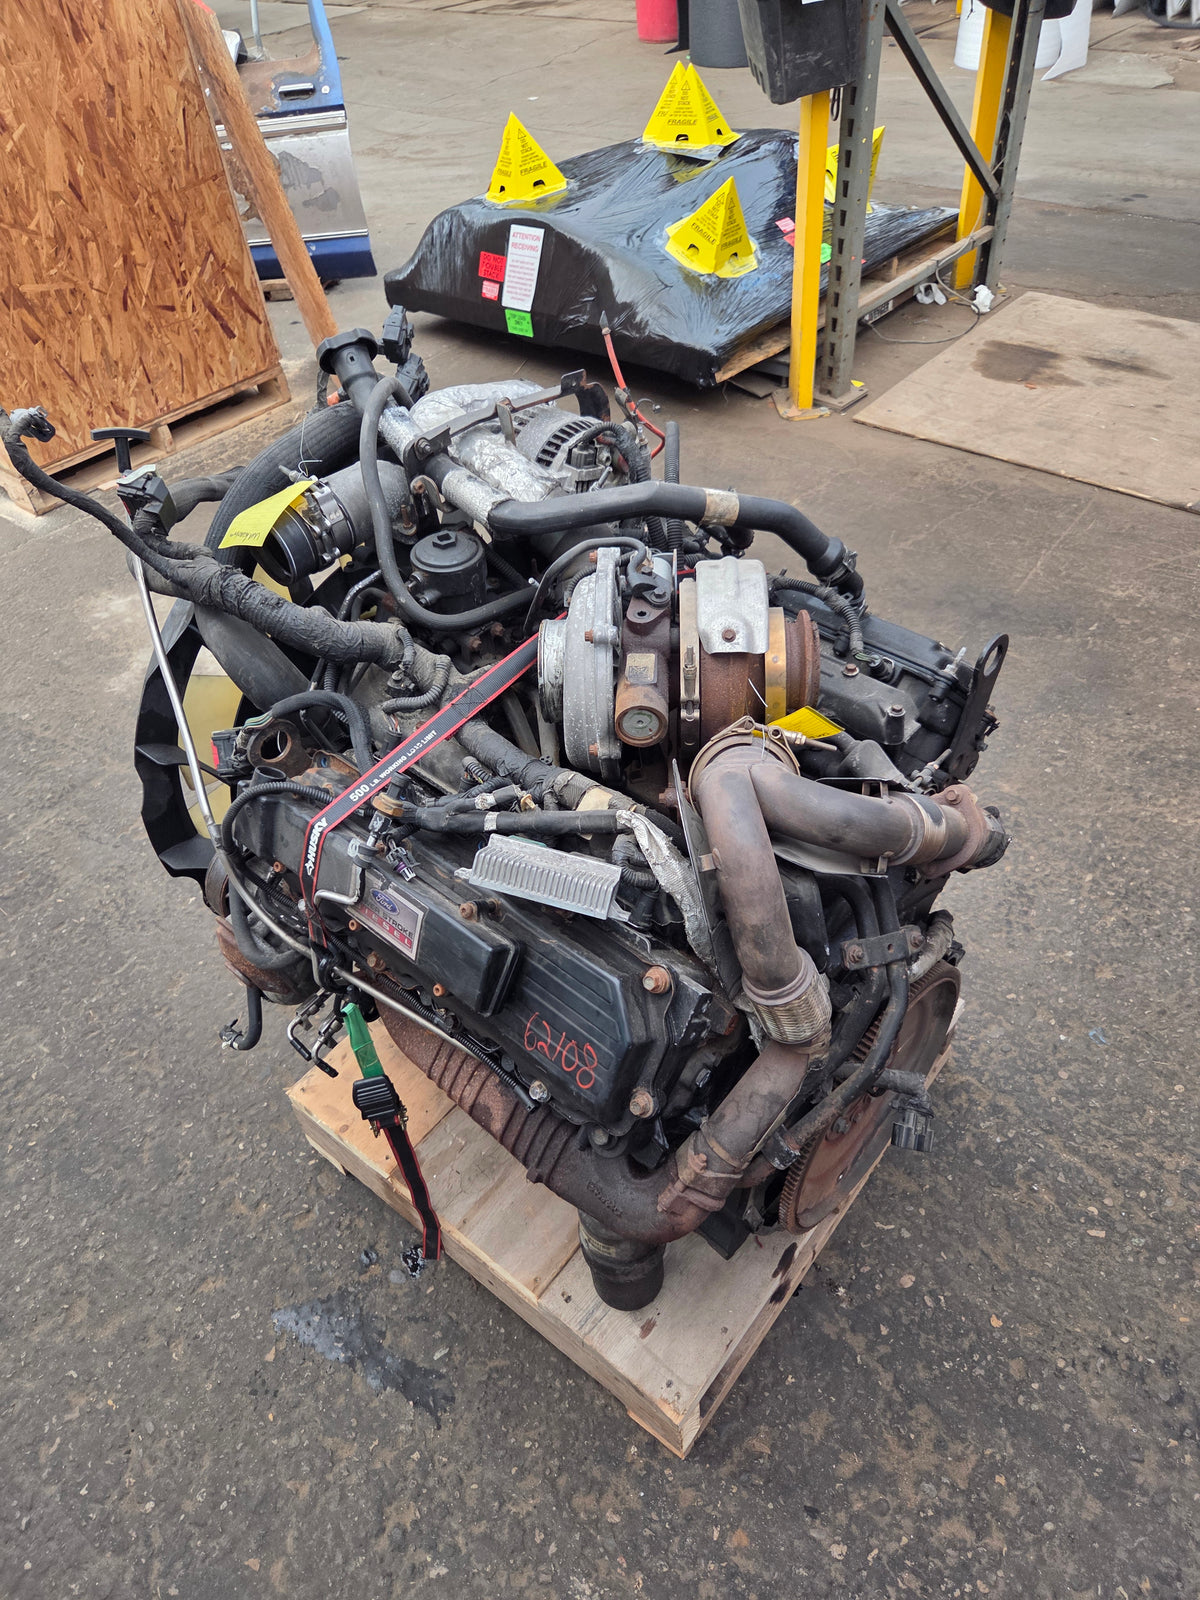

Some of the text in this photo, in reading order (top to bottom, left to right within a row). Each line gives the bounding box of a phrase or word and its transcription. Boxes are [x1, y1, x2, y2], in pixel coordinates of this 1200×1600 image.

[520, 161, 548, 176] FRAGILE
[512, 231, 541, 242] ATTENTION
[691, 222, 717, 245] FRAGILE
[511, 242, 539, 253] RECEIVING
[483, 253, 504, 264] DO NOT
[348, 783, 370, 802] 500
[379, 755, 408, 779] WORKING
[406, 742, 423, 757] LOAD
[422, 730, 437, 746] LIMIT
[307, 817, 329, 862] HUSKY
[375, 893, 394, 912] Ford
[383, 914, 415, 940] STROKE
[523, 1011, 599, 1090] 62108
